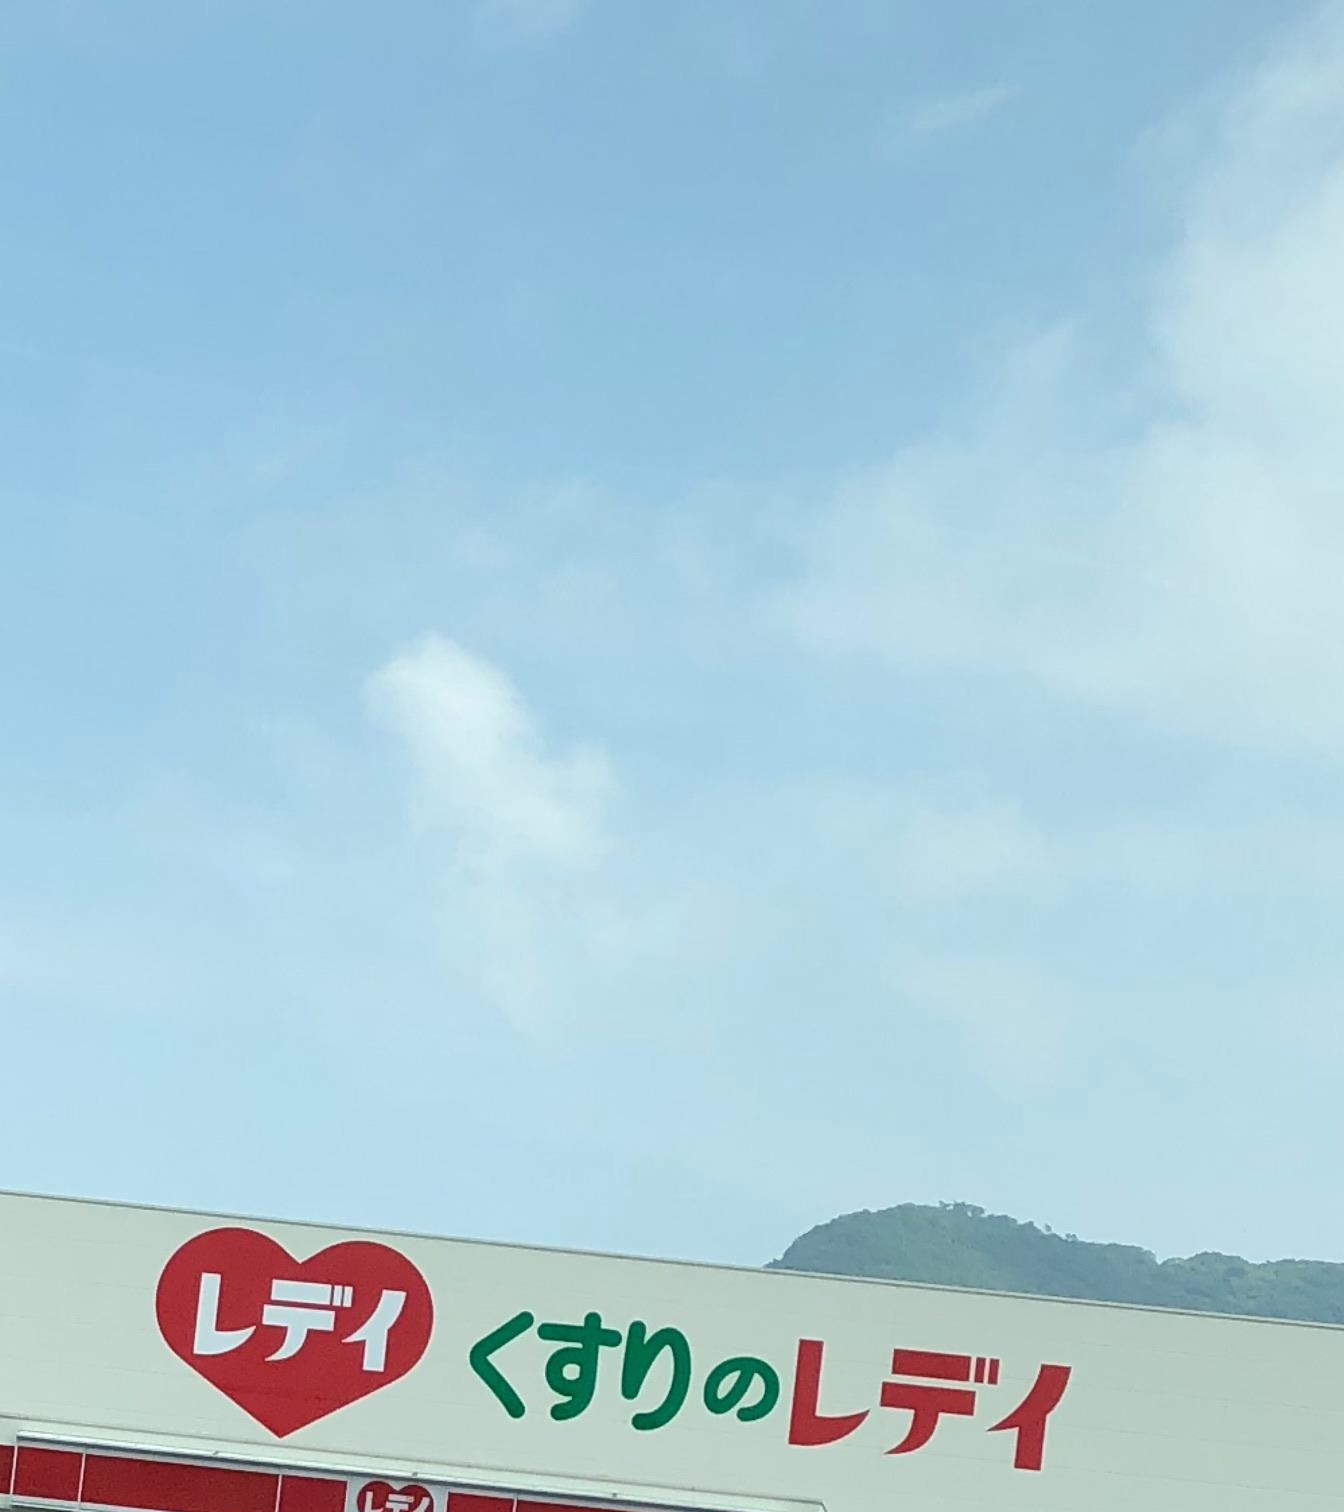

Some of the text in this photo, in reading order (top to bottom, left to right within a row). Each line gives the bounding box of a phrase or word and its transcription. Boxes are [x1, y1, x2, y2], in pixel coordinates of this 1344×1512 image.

[192, 1271, 407, 1373] レディ
[469, 1310, 1073, 1472] くすりのレディ
